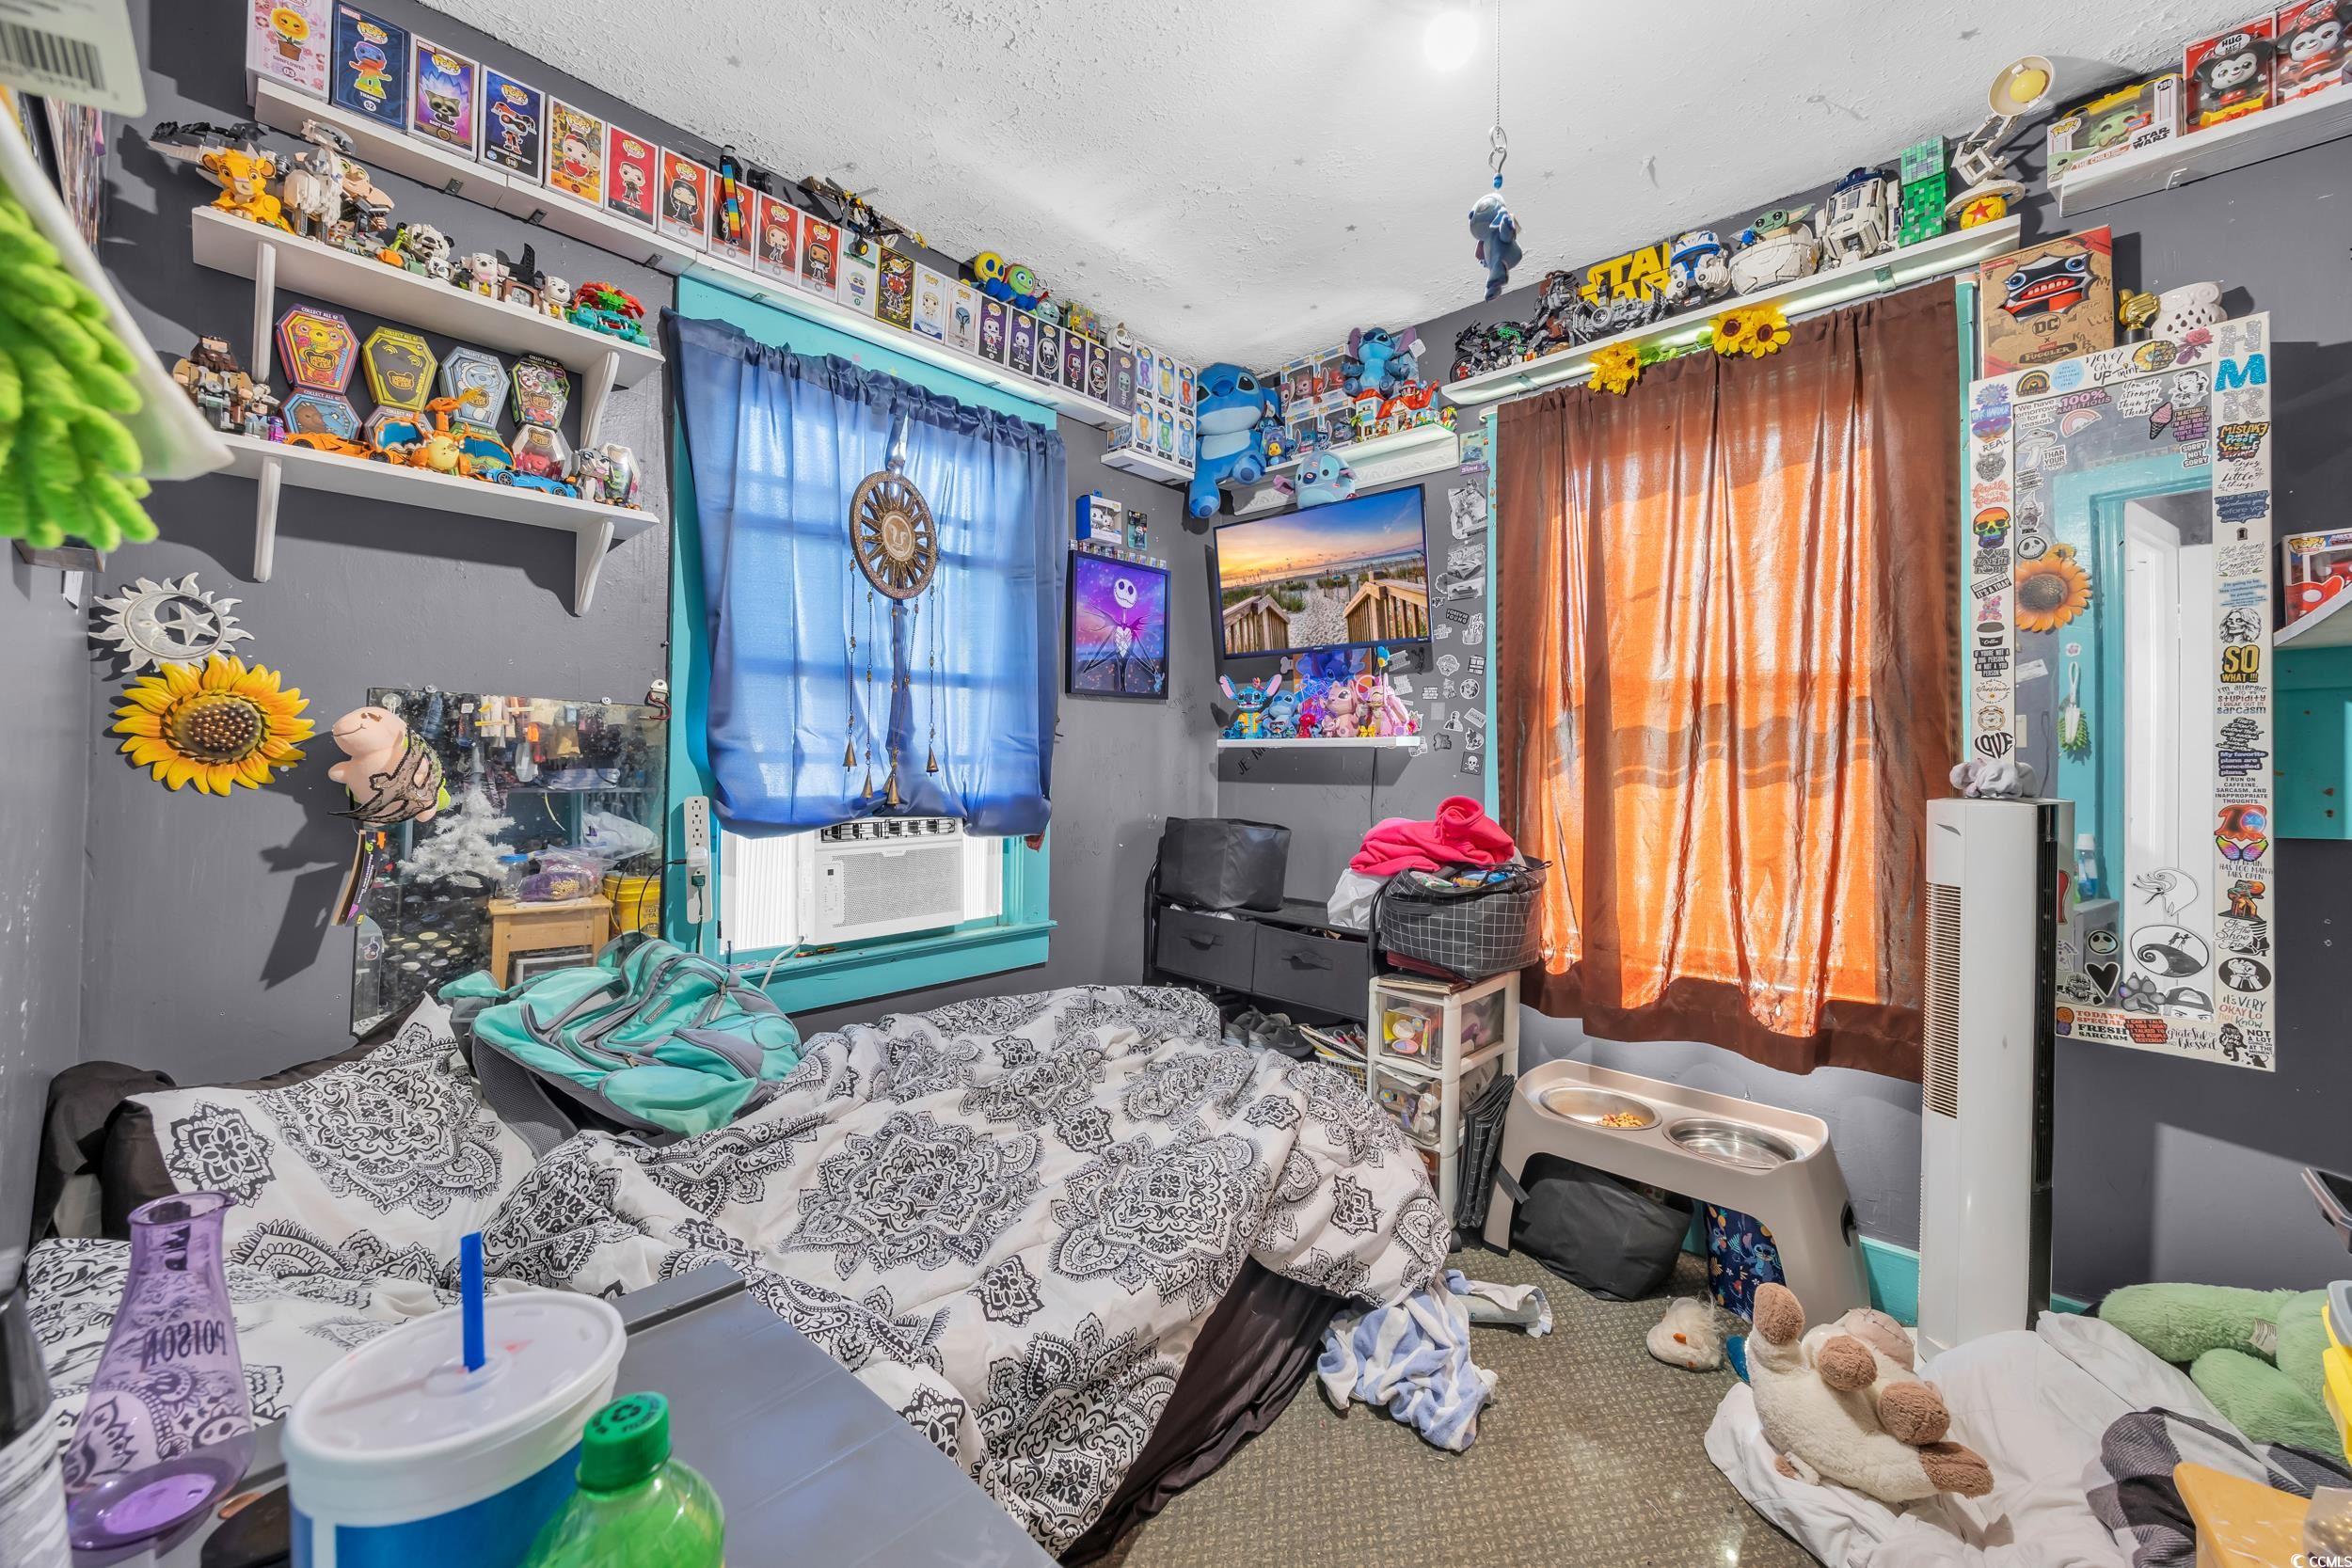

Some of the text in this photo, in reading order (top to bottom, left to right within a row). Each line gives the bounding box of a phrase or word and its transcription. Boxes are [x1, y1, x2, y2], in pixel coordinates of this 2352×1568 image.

[2221, 35, 2242, 47] HUG
[272, 55, 306, 71] SUNFLOWER
[365, 101, 375, 110] 52
[2051, 119, 2078, 137] POP!
[2137, 127, 2170, 142] STAR
[2132, 133, 2169, 150] WARS
[301, 307, 322, 316] COLLECT
[2033, 317, 2058, 331] DC
[2219, 321, 2262, 356] H
[2025, 346, 2071, 360] FUGGLER
[2094, 371, 2112, 385] UP
[2215, 354, 2267, 391] M
[2033, 399, 2055, 408] have
[2061, 389, 2106, 406] 100%
[2014, 404, 2059, 419] omorrows
[2057, 396, 2111, 414] AMBITIOUS
[2021, 419, 2055, 428] reason.
[1983, 437, 2010, 451] REAL
[2182, 442, 2206, 452] SORRY
[2043, 450, 2065, 459] THAN
[2043, 456, 2065, 465] YOUR
[2184, 456, 2208, 467] SORRY
[1975, 556, 2010, 565] FAITH
[1977, 578, 2010, 598] IT'S A TRAP
[1447, 610, 1469, 619] FOREVER
[1447, 614, 1468, 624] YOUNG
[2224, 645, 2260, 673] SO
[2221, 673, 2248, 682] WHAT
[2233, 685, 2267, 693] allergic
[1975, 732, 2014, 759] LOVE
[2216, 927, 2250, 940] Shoe
[2238, 995, 2267, 1012] VERY
[2075, 1010, 2125, 1020] TODAY'S
[2218, 1004, 2247, 1017] OKAY
[2078, 1023, 2127, 1035] FRESH
[2078, 1031, 2128, 1040] SARCASM
[2178, 1037, 2217, 1051] blessed
